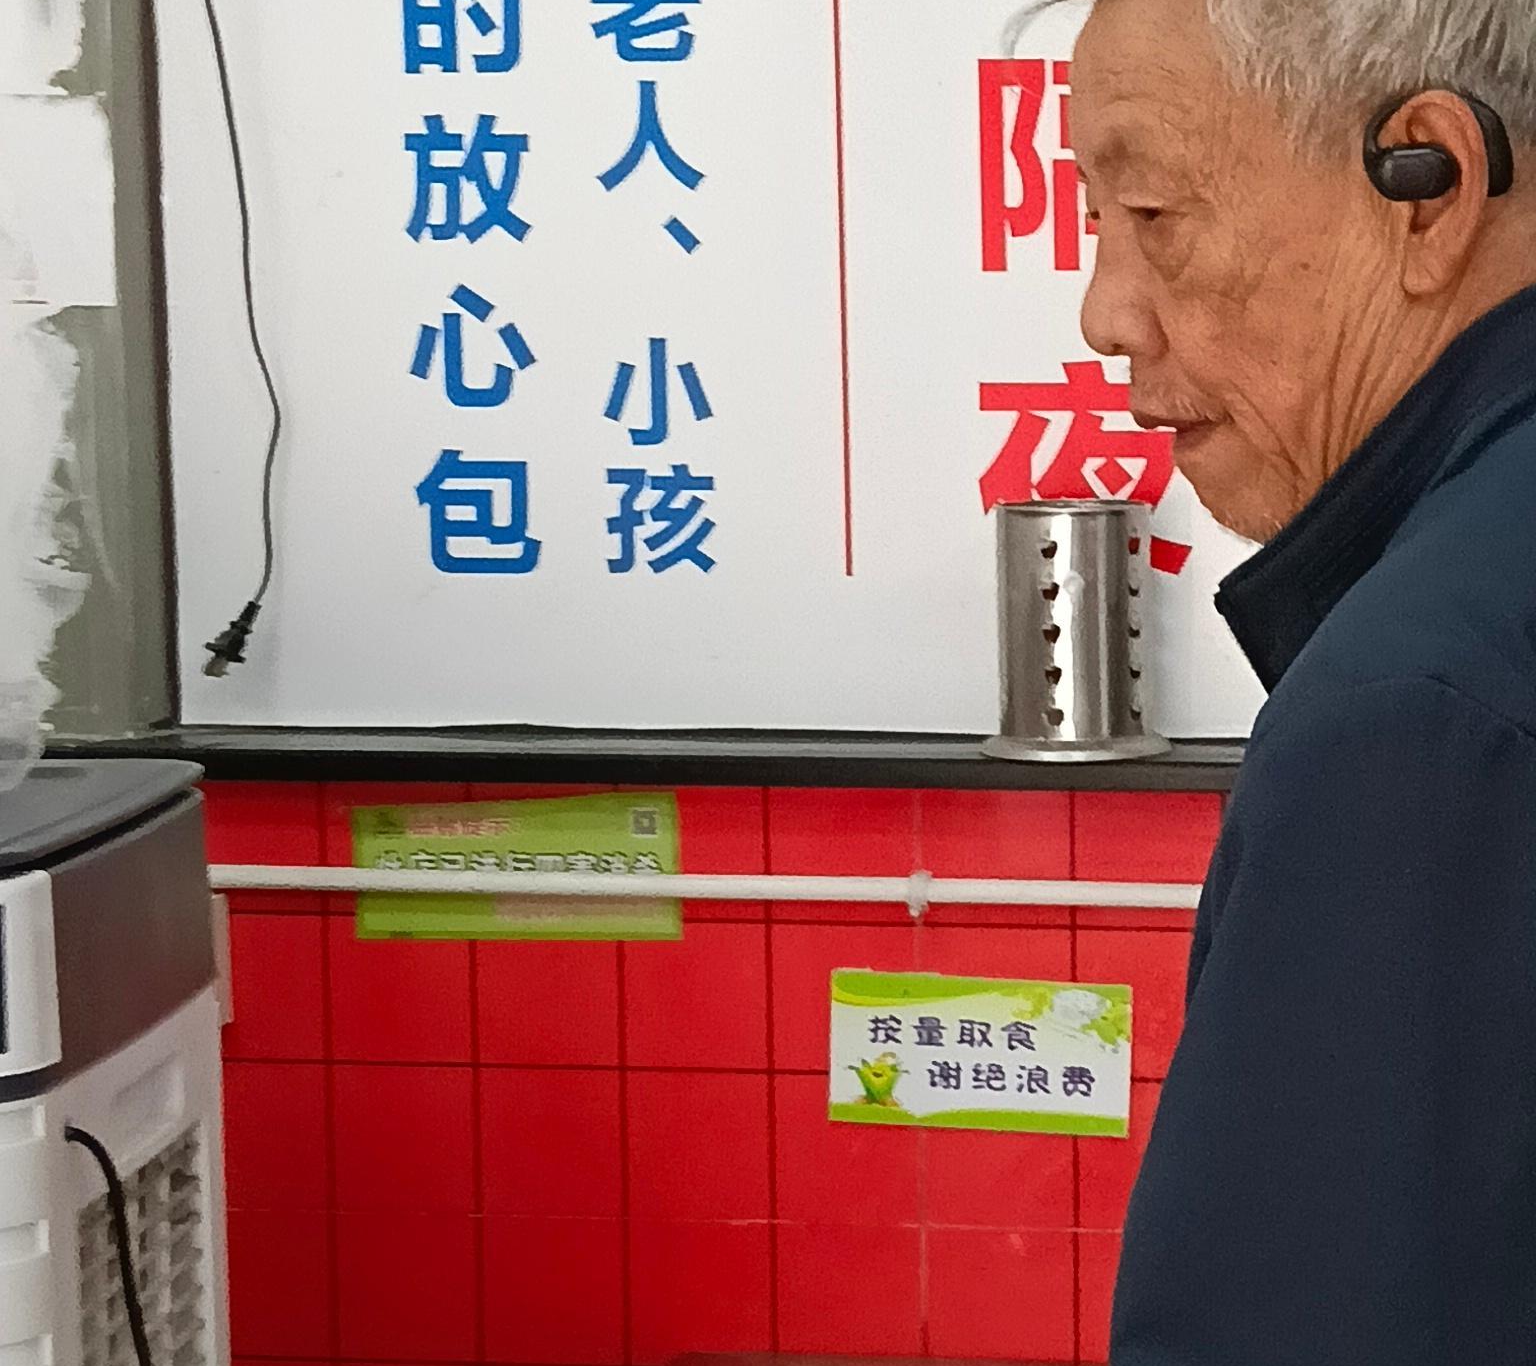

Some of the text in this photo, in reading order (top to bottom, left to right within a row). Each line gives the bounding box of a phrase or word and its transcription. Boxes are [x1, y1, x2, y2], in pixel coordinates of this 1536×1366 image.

[868, 1014, 1037, 1052] 按量取食
[926, 1059, 1097, 1098] 谢绝浪费
